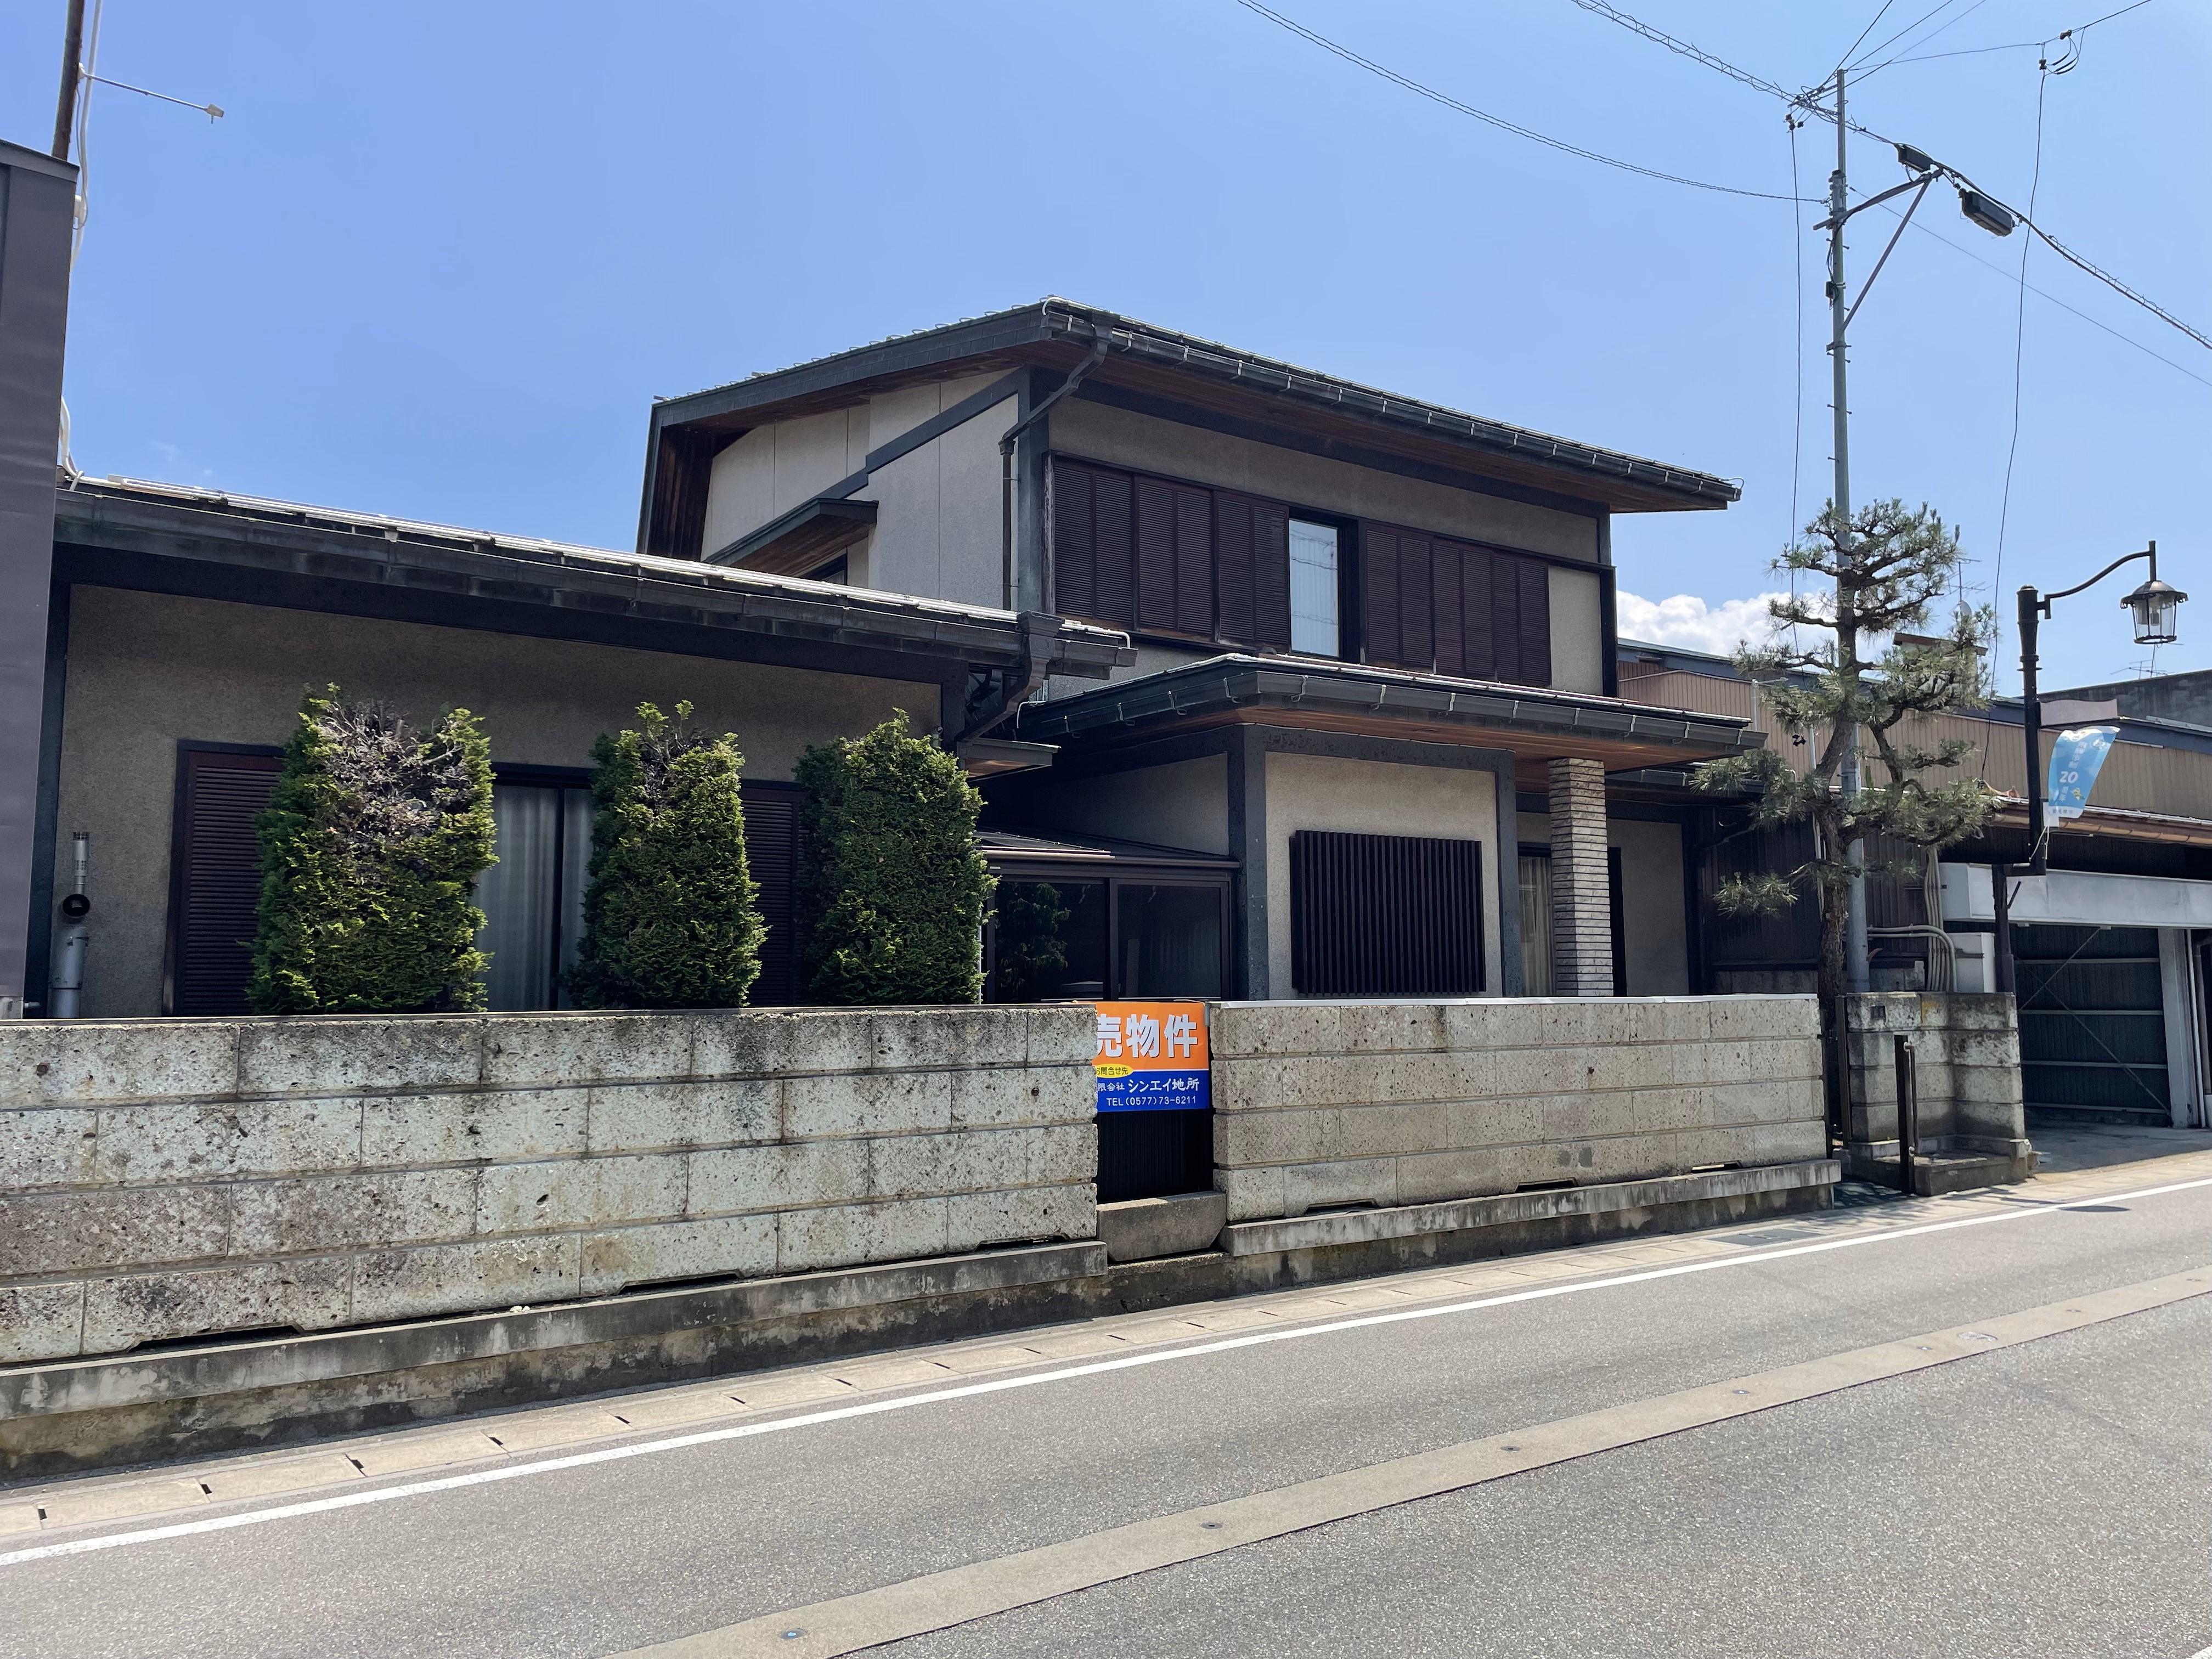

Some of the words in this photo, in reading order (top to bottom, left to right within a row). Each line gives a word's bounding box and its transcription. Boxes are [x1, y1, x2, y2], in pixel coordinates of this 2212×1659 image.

[2059, 771, 2079, 783] 20
[1097, 1014, 1198, 1058] 売物件
[1128, 1077, 1200, 1093] シンエイ地所
